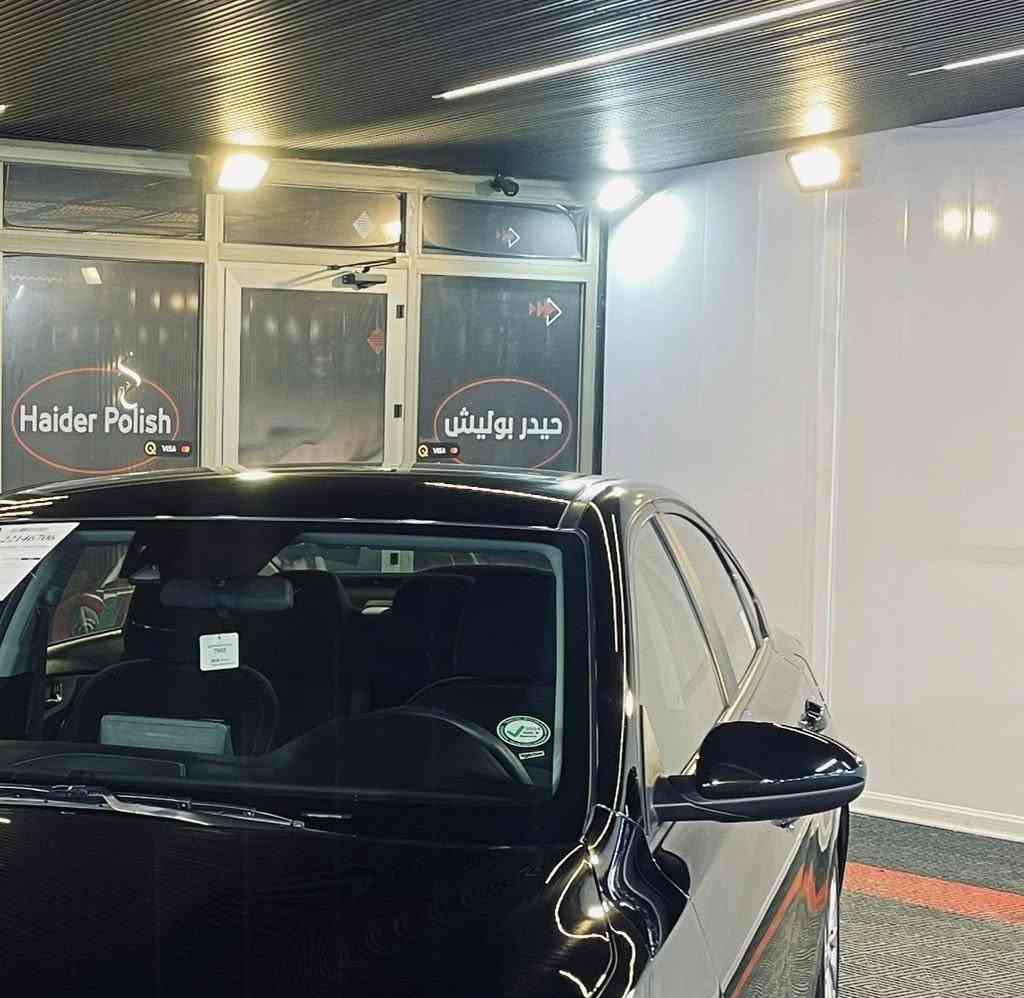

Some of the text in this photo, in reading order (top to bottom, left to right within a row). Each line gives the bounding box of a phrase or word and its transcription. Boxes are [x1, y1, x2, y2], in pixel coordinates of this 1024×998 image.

[19, 404, 172, 435] Haider Polish
[444, 407, 563, 440] حيدر بوليش
[161, 445, 177, 453] VISA
[432, 447, 446, 455] VISA
